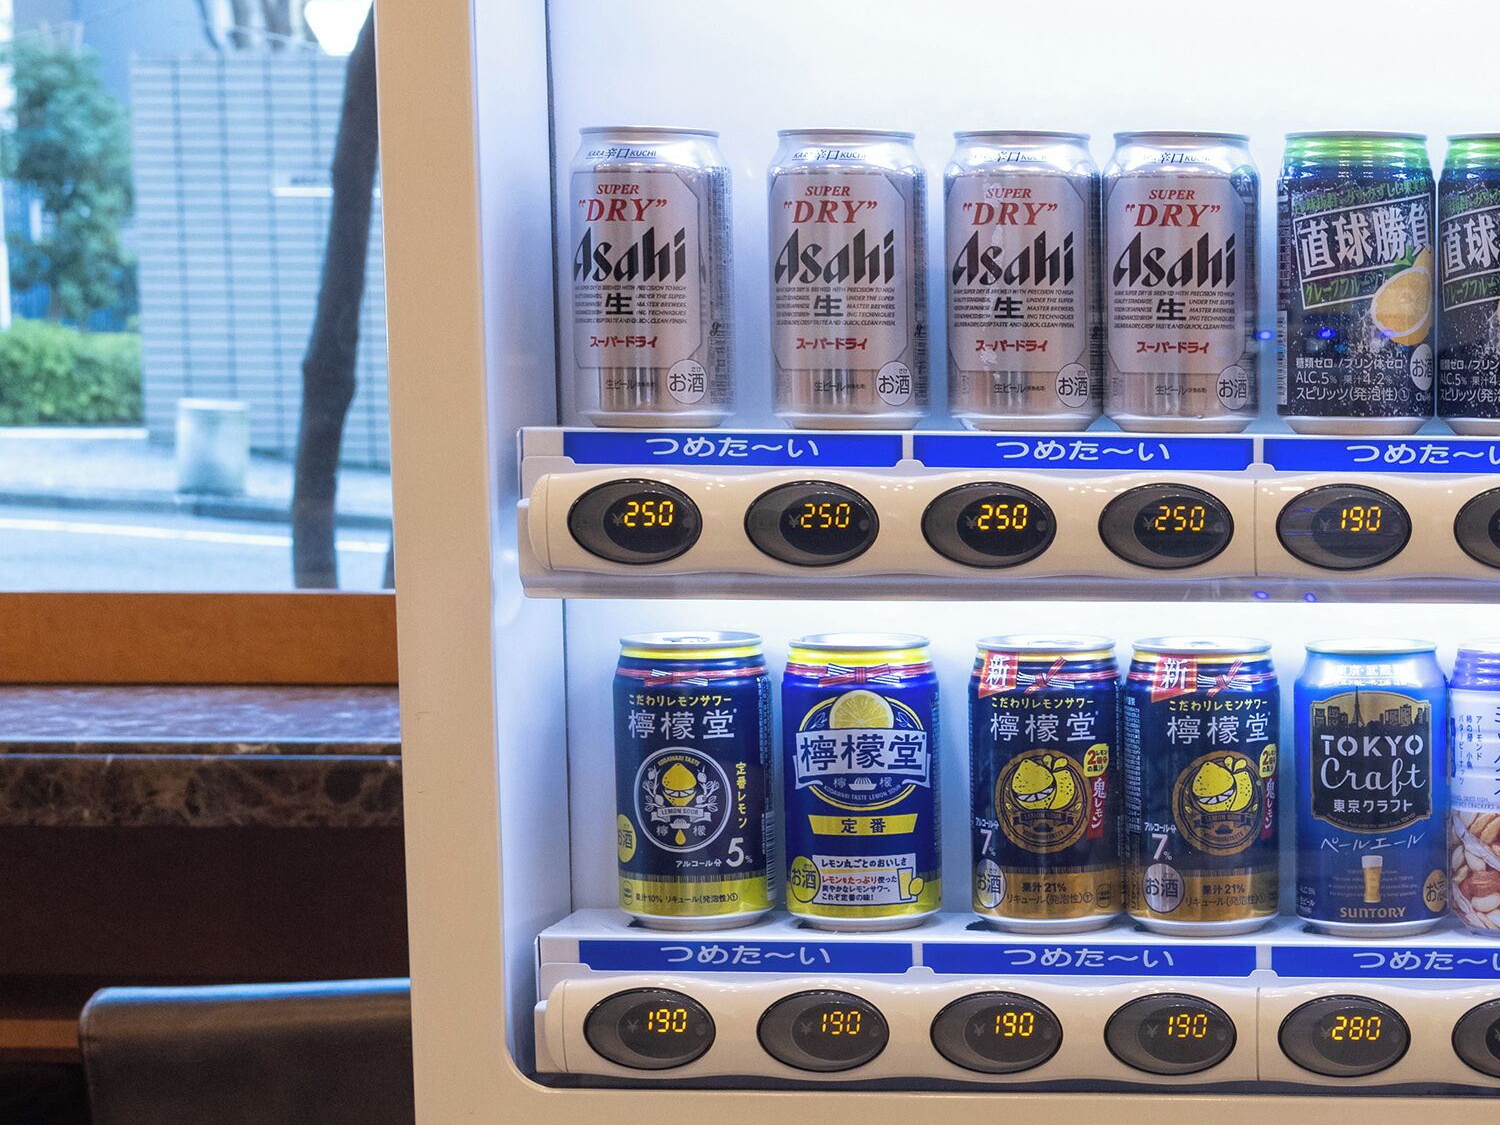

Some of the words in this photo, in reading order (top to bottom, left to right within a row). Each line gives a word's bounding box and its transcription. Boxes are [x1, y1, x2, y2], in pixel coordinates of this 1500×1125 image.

[1149, 189, 1195, 200] SUPER
[1297, 203, 1431, 275] 直球勝負
[573, 226, 686, 283] Asahi
[774, 228, 895, 285] Asahi
[952, 230, 1074, 286] Asahi
[1113, 231, 1236, 288] Asahi
[590, 336, 658, 348] スーパードライ
[796, 338, 868, 350] スーパードライ
[975, 339, 1048, 352] スーパードライ
[1136, 341, 1210, 354] スーパードライ
[623, 500, 674, 527] 250
[800, 503, 850, 529] 250
[977, 504, 1028, 530] 250
[1154, 506, 1205, 531] 250
[1340, 506, 1382, 532] 190
[986, 654, 1011, 690] 新
[1160, 658, 1190, 689] 新
[629, 694, 732, 707] こだわりレモンサワー
[991, 697, 1094, 709] こだわりレモンサワー
[1169, 699, 1268, 712] こだわりレモンサワー
[628, 709, 735, 740] 檸檬堂
[990, 712, 1096, 742] 檸檬堂
[1167, 712, 1269, 745] 檸檬堂
[800, 733, 923, 772] 檸檬堂
[1320, 734, 1424, 757] TOKYO
[1320, 757, 1426, 797] Craft
[1333, 799, 1413, 812] 東京クラフト
[841, 818, 886, 834] 定番
[1320, 832, 1426, 853] ペールエール
[1145, 877, 1179, 898] お酒
[1339, 907, 1406, 918] SUNTORY
[648, 1008, 687, 1033] 190
[822, 1011, 861, 1035] 190
[995, 1012, 1035, 1037] 190
[1168, 1014, 1208, 1038] 190
[1331, 1016, 1381, 1041] 280
